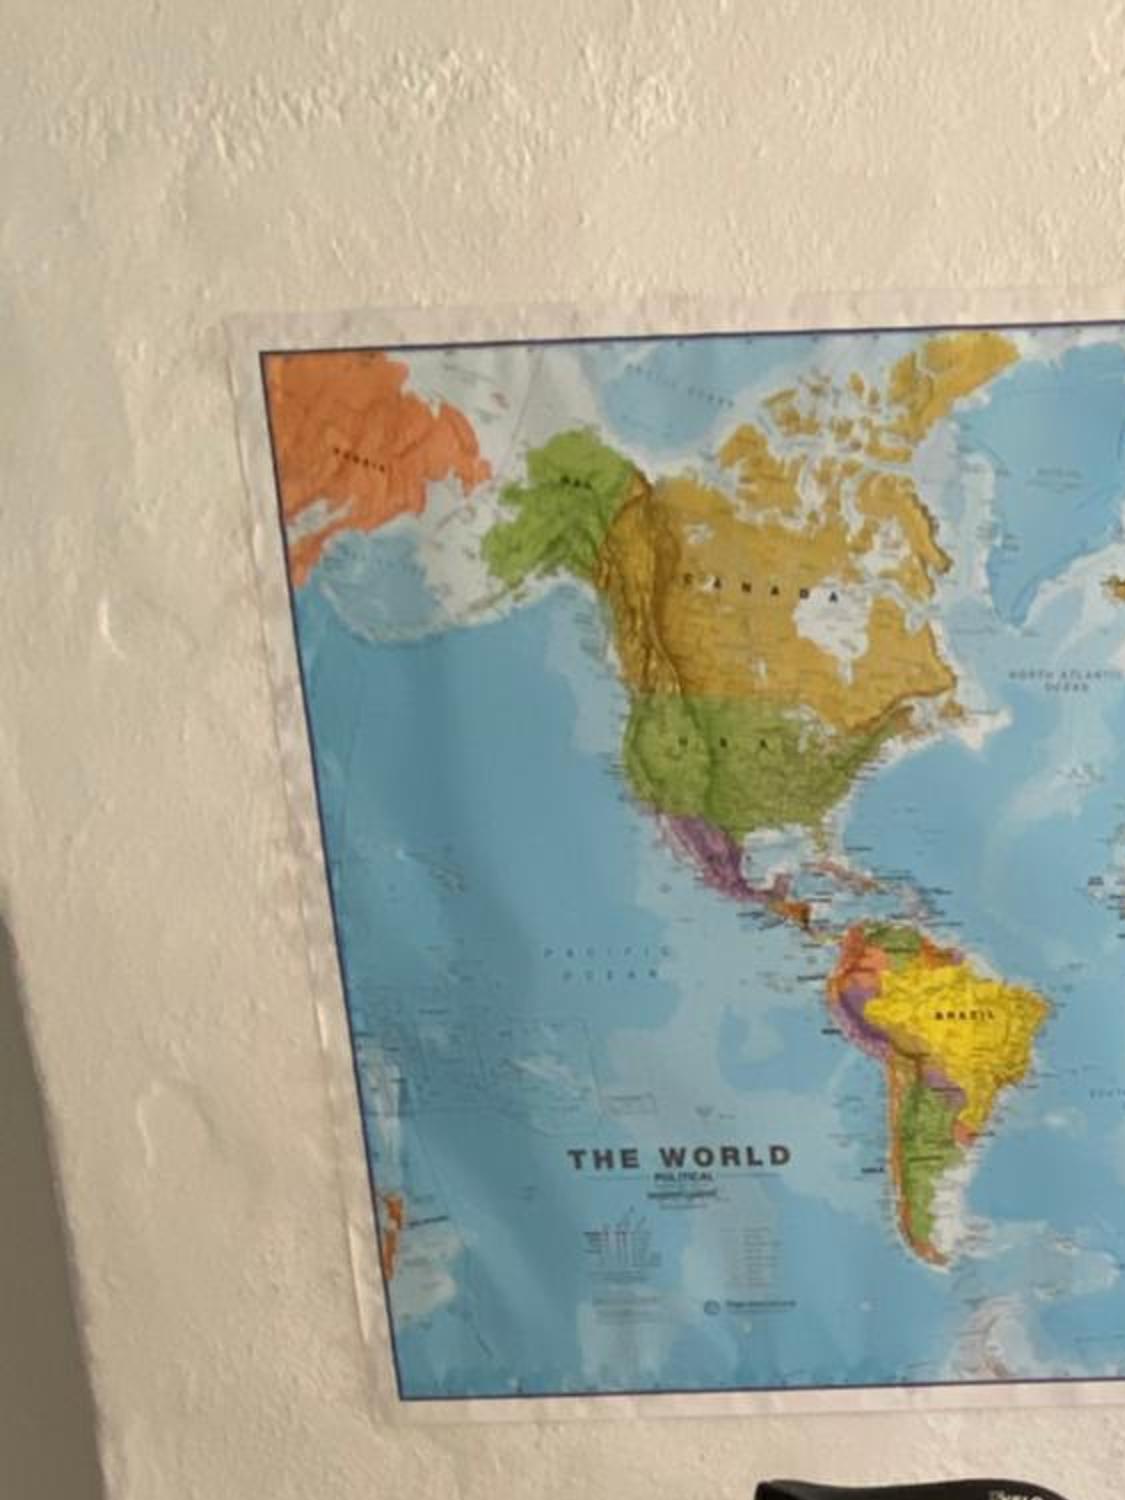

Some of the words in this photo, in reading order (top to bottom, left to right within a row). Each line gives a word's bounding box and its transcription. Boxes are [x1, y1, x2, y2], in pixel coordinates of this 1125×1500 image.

[682, 572, 839, 604] CANADA
[567, 1148, 640, 1170] THE
[659, 1145, 792, 1168] WORLD
[653, 1171, 715, 1183] POLITICAL
